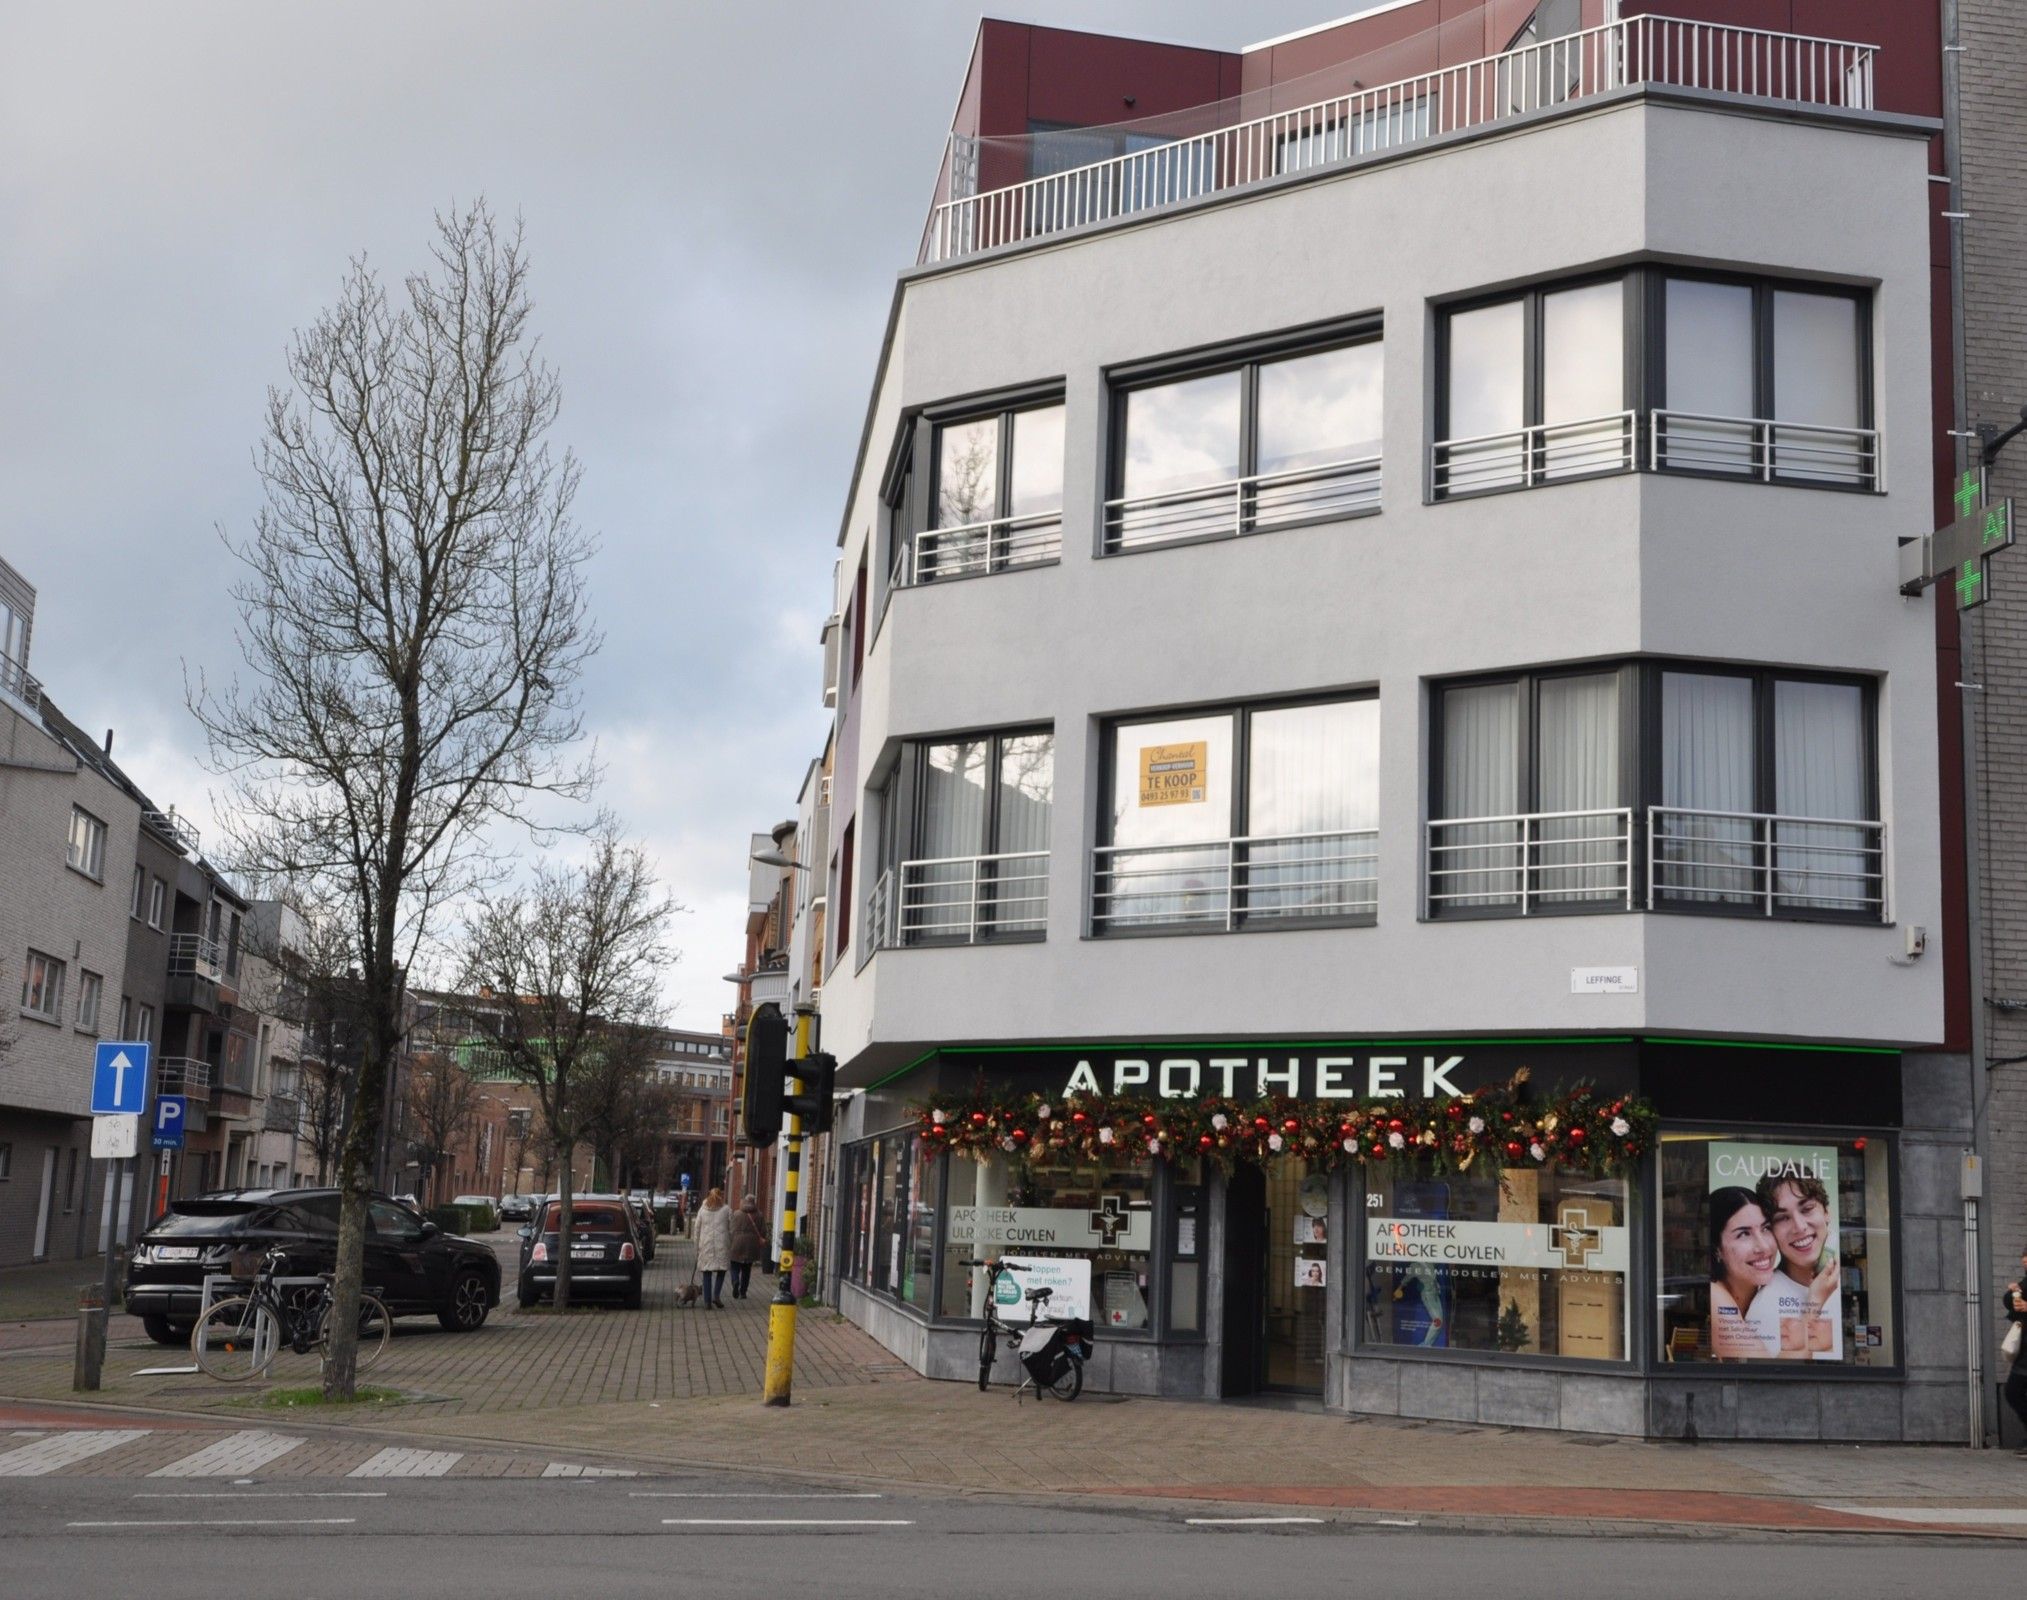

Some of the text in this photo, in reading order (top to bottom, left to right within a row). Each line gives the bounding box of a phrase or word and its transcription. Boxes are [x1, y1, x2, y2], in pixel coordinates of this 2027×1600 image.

[1148, 773, 1197, 788] TE KOOP
[1585, 975, 1623, 984] LEFFINGE
[1062, 1056, 1464, 1098] APOTHEEK
[158, 1101, 181, 1129] P
[1715, 1152, 1831, 1180] CAUDALÍE
[1367, 1194, 1383, 1207] 251
[954, 1210, 1017, 1223] APOHEEK
[952, 1226, 1055, 1241] ULRKE CUYLEN
[1376, 1223, 1456, 1239] APOTHEEK
[1375, 1243, 1505, 1261] ULRICKE CUYLEN
[1375, 1265, 1625, 1285] GENEESMIDDELEN MET ADVIES
[1779, 1297, 1800, 1307] 86%
